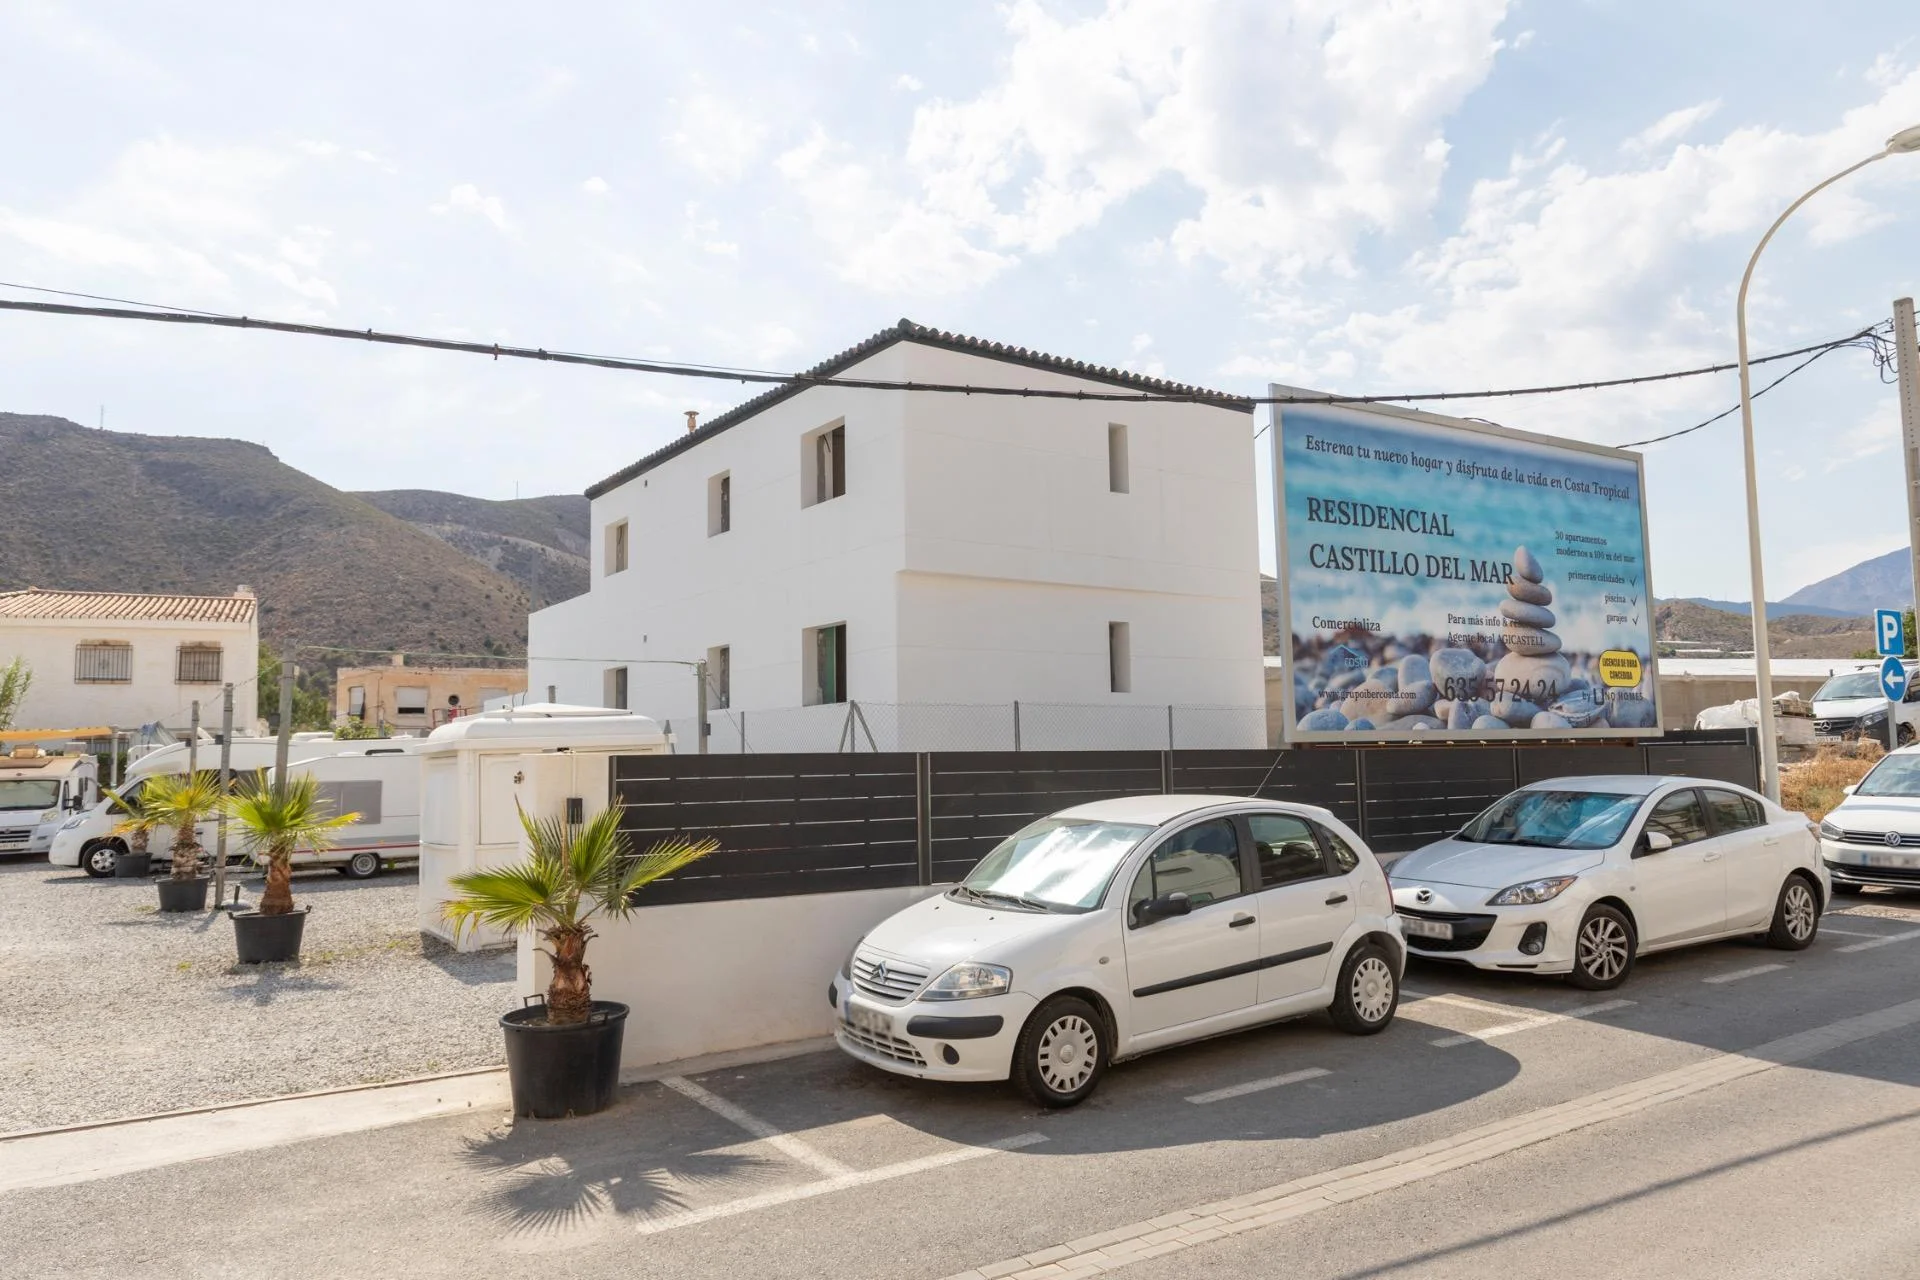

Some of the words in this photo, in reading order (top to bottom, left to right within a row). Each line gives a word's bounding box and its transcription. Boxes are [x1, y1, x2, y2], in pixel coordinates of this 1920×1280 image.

[1306, 435, 1353, 457] Estrena
[1357, 445, 1370, 458] tu
[1374, 450, 1408, 464] nuevo
[1411, 452, 1443, 473] hogar
[1446, 460, 1453, 475] y
[1456, 460, 1498, 480] disfruta
[1501, 467, 1512, 482] de
[1515, 469, 1524, 484] la
[1527, 472, 1548, 487] vida
[1551, 479, 1562, 489] en
[1564, 477, 1590, 494] Costa
[1592, 481, 1630, 501] Tropical
[1306, 496, 1455, 537] RESIDENCIAL
[1565, 534, 1607, 546] apartamentos
[1556, 547, 1588, 558] modernos
[1309, 543, 1420, 577] CASTILLO
[1425, 554, 1465, 581] DEL
[1470, 559, 1515, 585] MAR
[1568, 571, 1597, 582] primeras
[1597, 572, 1625, 584] calidades
[1604, 593, 1626, 604] piscina
[1312, 615, 1381, 631] Comercializa
[1447, 613, 1466, 625] Para
[1468, 614, 1484, 626] más
[1485, 616, 1500, 627] info
[1606, 613, 1628, 624] garajes
[1447, 632, 1477, 646] Agente
[1478, 633, 1495, 644] local
[1498, 634, 1545, 646] AGICASTELL
[1882, 615, 1898, 650] P
[1318, 689, 1416, 701] www.grupoibercosta.com
[1444, 676, 1478, 702] 635
[1487, 678, 1505, 703] 57
[1511, 678, 1531, 702] 24
[1537, 679, 1558, 702] 24
[1582, 691, 1590, 702] by
[1617, 692, 1643, 701] HOMES
